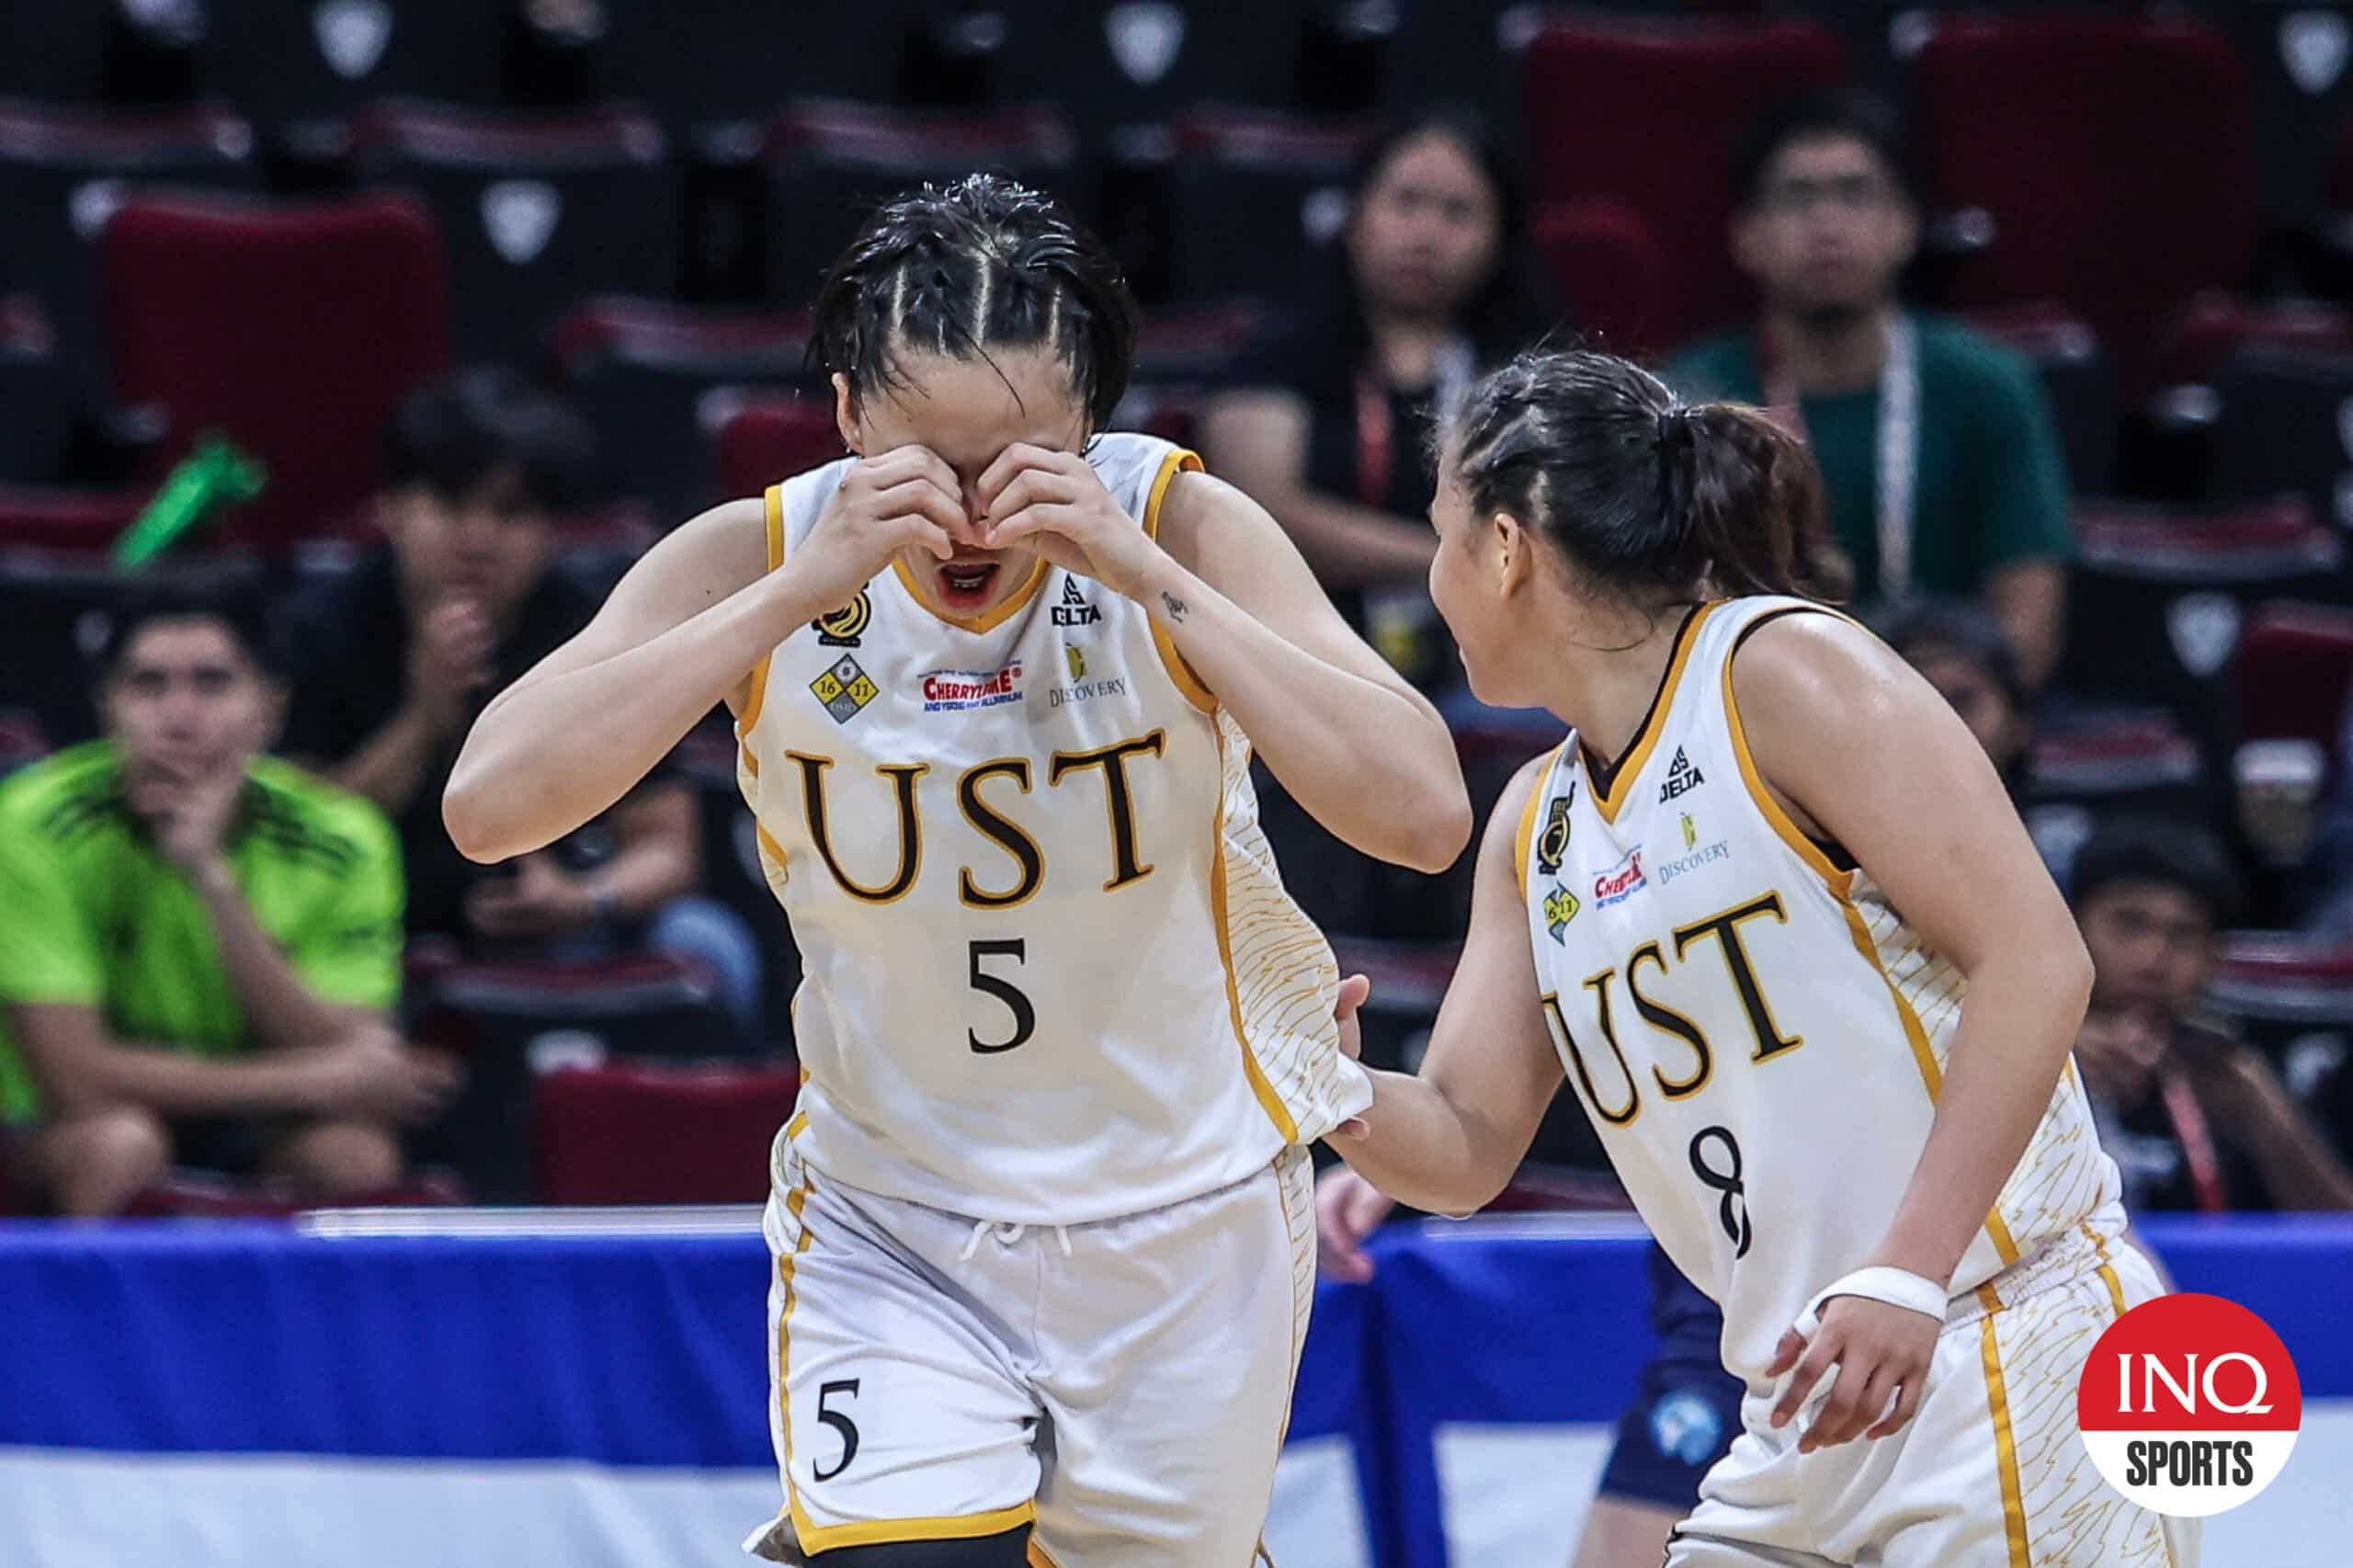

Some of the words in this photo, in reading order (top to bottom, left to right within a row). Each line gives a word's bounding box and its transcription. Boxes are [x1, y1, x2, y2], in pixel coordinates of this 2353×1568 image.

[820, 680, 835, 695] 16
[854, 683, 869, 697] 11
[785, 728, 1166, 910] UST
[1658, 767, 1705, 805] DELTA
[1659, 840, 1731, 885] DISCOVERY
[967, 937, 1036, 1055] 5
[1541, 889, 1805, 1129] UST
[1688, 1125, 1753, 1260] 8
[813, 1378, 861, 1483] 5
